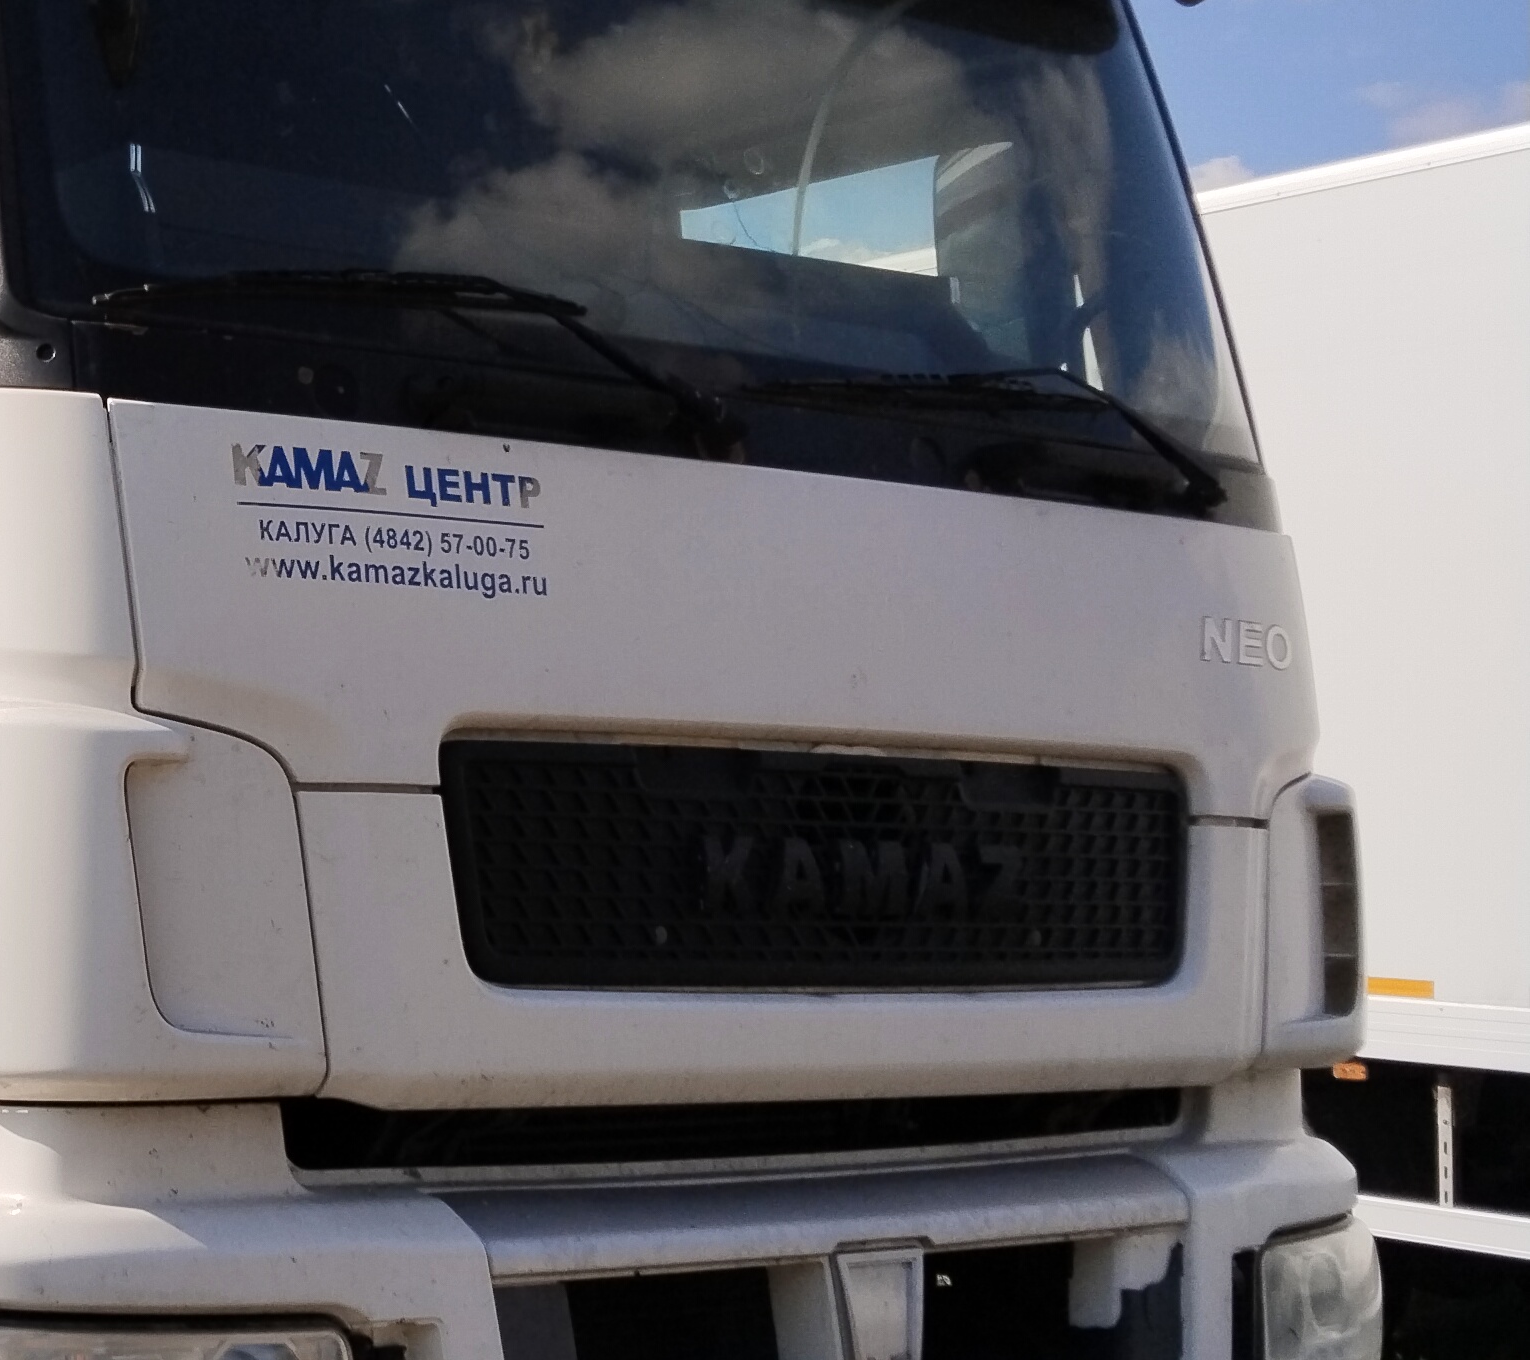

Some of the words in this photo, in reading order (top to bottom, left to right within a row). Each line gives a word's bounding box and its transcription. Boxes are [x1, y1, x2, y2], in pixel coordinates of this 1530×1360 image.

[231, 443, 387, 496] KAMAZ
[404, 465, 541, 508] ЦЕНТР
[258, 519, 356, 546] КАЛУГА
[364, 525, 433, 557] (4842)
[440, 532, 530, 559] 57-00-75
[244, 555, 548, 599] www.kamazkaluga.ru
[1200, 616, 1292, 671] NEO
[700, 836, 1036, 915] KAMAZ
